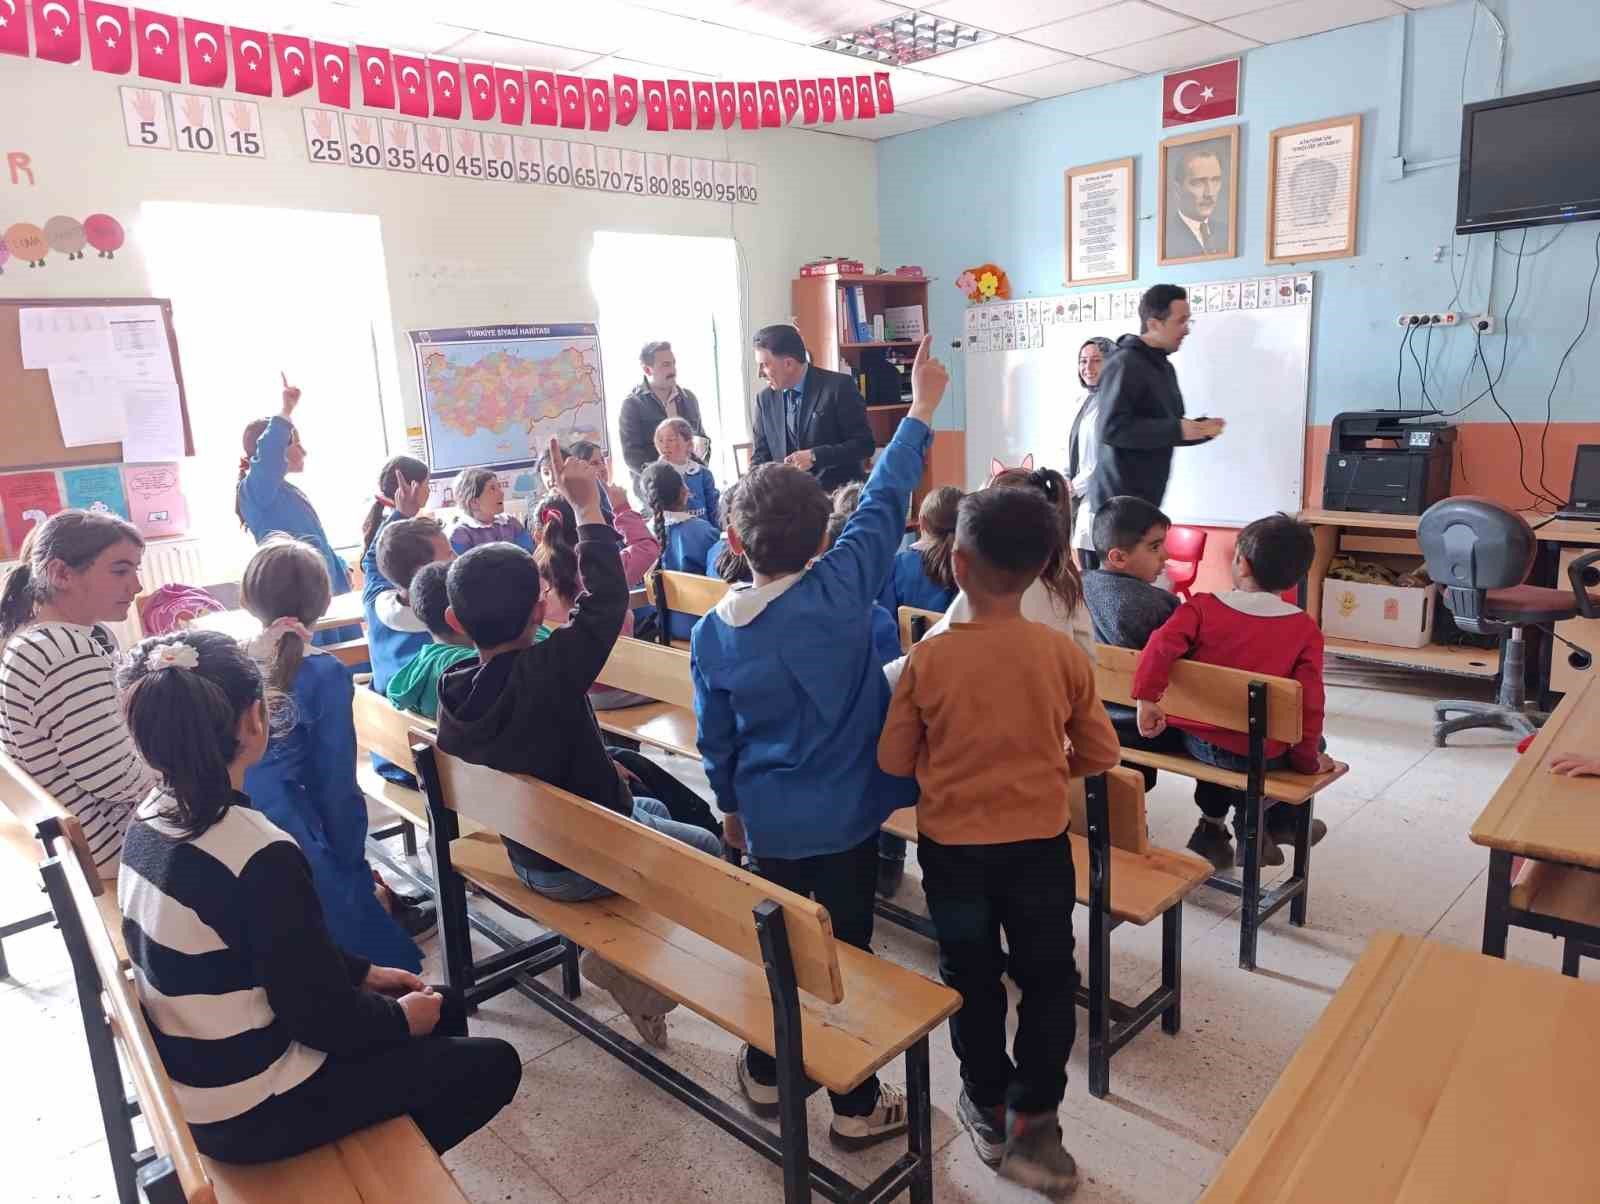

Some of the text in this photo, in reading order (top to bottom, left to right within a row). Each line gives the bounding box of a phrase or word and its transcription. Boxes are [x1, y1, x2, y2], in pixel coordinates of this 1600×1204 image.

[140, 121, 260, 154] 5 10 15
[8, 151, 35, 185] R
[312, 139, 758, 201] 25 30 35 40 45 50 55 60 65 70 75 80 85 90 95 100
